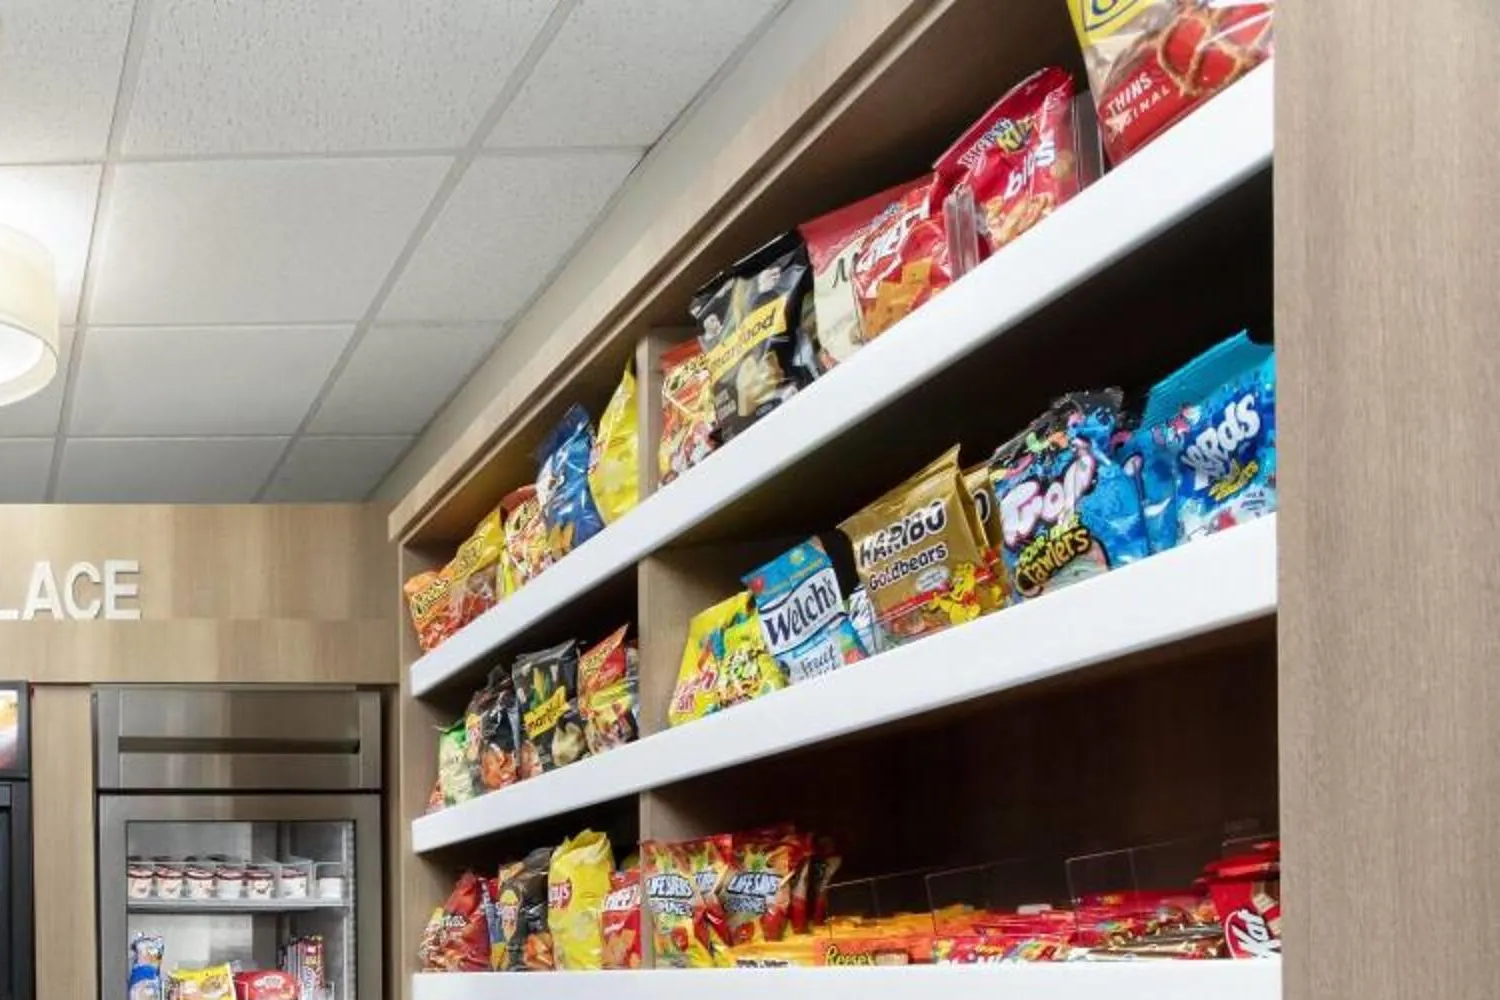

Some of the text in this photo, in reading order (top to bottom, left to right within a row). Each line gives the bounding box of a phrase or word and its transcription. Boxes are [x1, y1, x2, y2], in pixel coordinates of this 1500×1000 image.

[1108, 72, 1153, 118] THINS
[857, 499, 948, 568] HARIBO
[868, 543, 948, 592] Goldbears
[763, 574, 840, 647] Welch's
